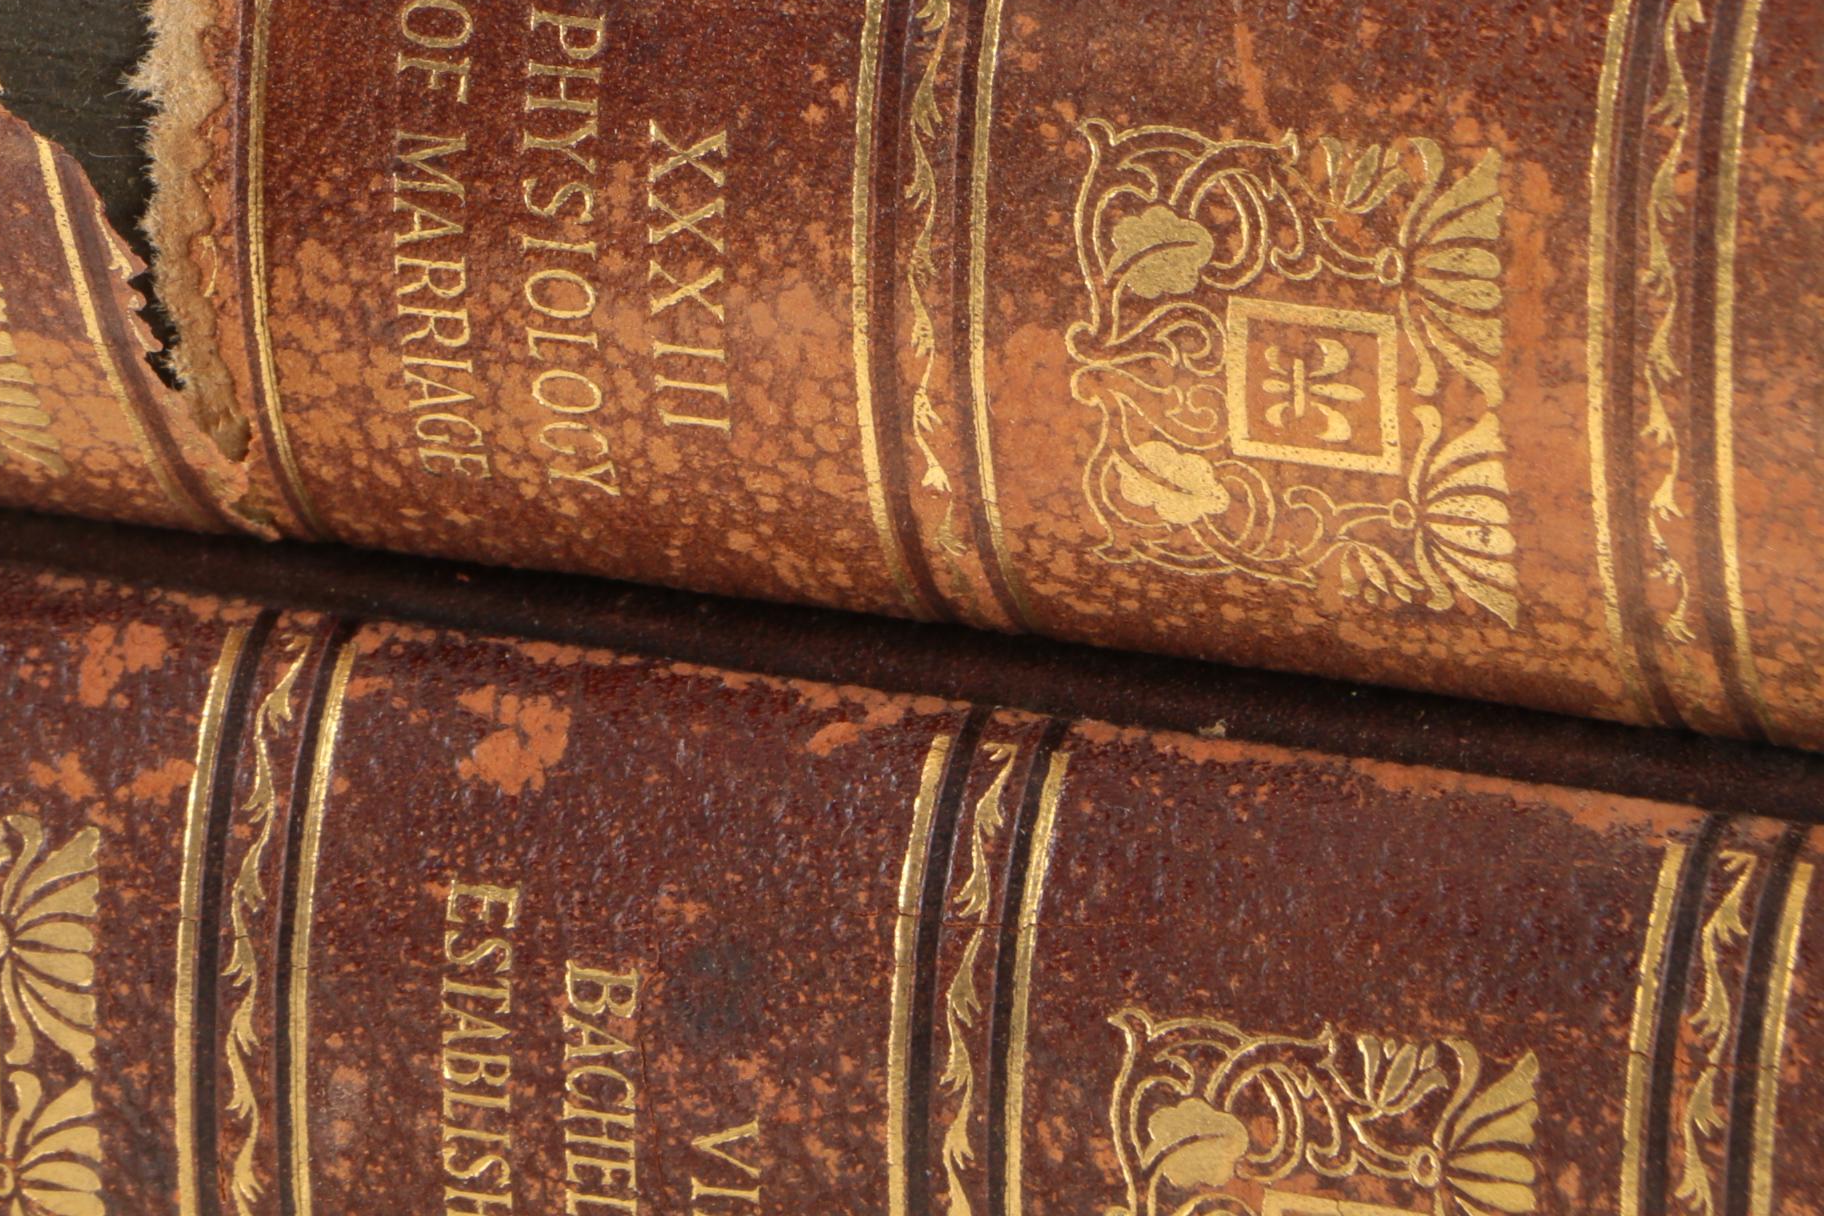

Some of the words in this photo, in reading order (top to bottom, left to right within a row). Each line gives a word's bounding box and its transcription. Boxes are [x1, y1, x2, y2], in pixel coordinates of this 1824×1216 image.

[392, 130, 491, 480] MARRIAGE
[522, 7, 621, 497] PHYSIOLOGY
[648, 119, 732, 438] XXXIII
